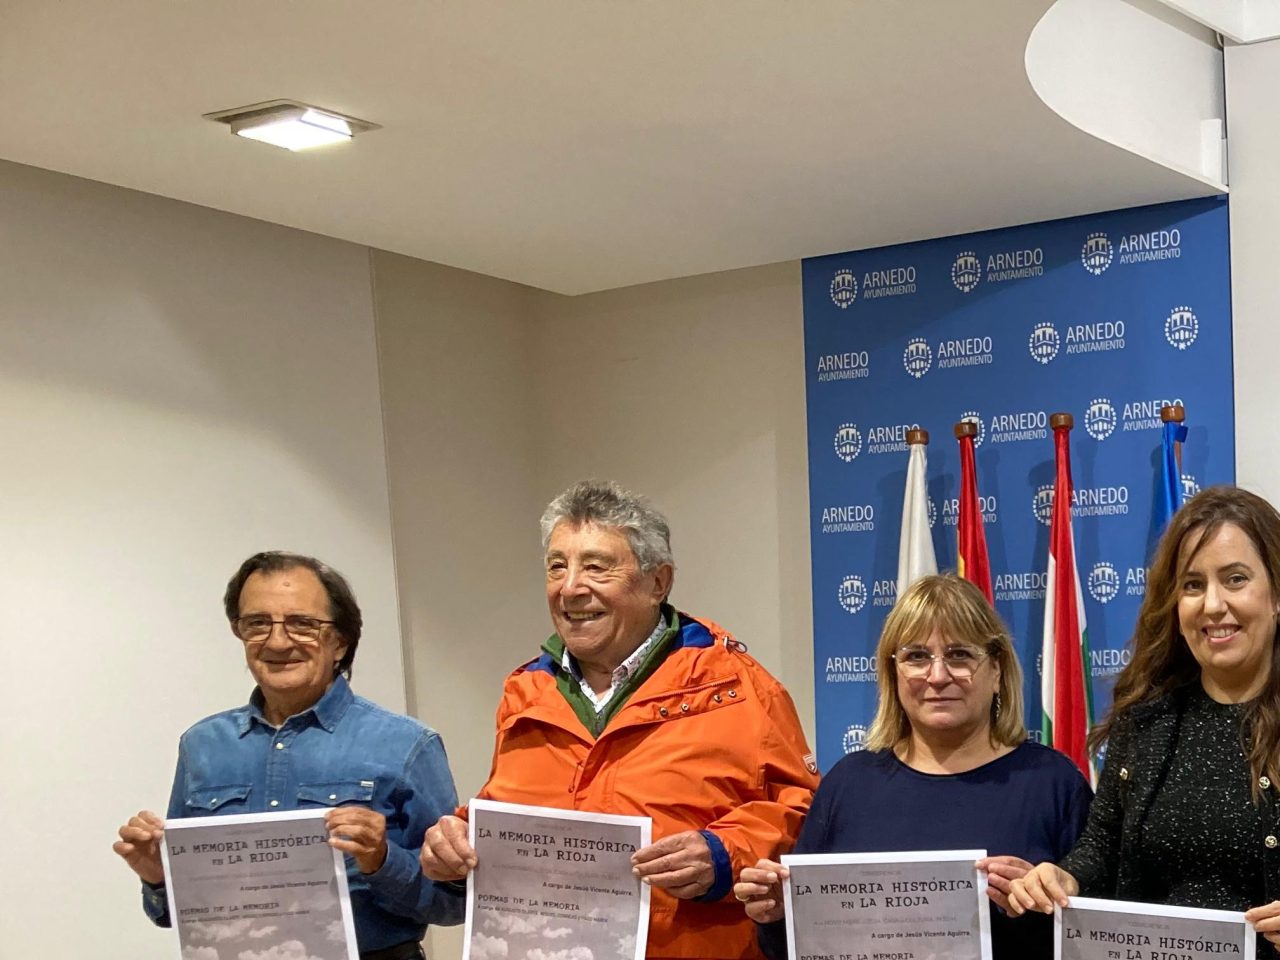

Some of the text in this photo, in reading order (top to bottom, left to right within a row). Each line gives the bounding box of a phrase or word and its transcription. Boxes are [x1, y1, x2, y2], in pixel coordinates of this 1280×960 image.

[1120, 229, 1180, 253] ARNEDO
[987, 248, 1044, 271] ARNEDO
[1120, 247, 1180, 264] AYUNTAMIENTO
[863, 266, 916, 288] ARNEDO
[988, 265, 1044, 282] AYUNTAMIENTO
[864, 284, 916, 299] AYUNTAMIENTO
[1066, 320, 1125, 343] ARNEDO
[938, 336, 992, 358] ARNEDO
[1066, 338, 1125, 354] AYUNTAMIENTO
[818, 351, 868, 372] ARNEDO
[938, 353, 992, 369] AYUNTAMIENTO
[818, 368, 868, 382] AYUNTAMIENTO
[991, 412, 1046, 433] ARNEDO
[991, 428, 1046, 444] AYUNTAMIENTO
[943, 496, 996, 515] ARDO
[822, 505, 873, 524] ARNEDO
[823, 520, 873, 533] AYUNTAMIENTO
[479, 828, 491, 838] LA
[500, 831, 555, 845] MEMORIA
[171, 846, 186, 856] LA
[193, 841, 248, 854] MEMORIA
[534, 848, 548, 857] LA
[557, 850, 596, 862] RIOJA
[229, 855, 242, 864] LA
[250, 852, 288, 863] RIOJA
[796, 878, 973, 896] LA MEMORIA HISTÓRICA
[842, 897, 929, 909] EN LA RIOJA
[1067, 928, 1240, 953] LA MEMORIA HISTÓRICA
[1126, 950, 1142, 960] LA
